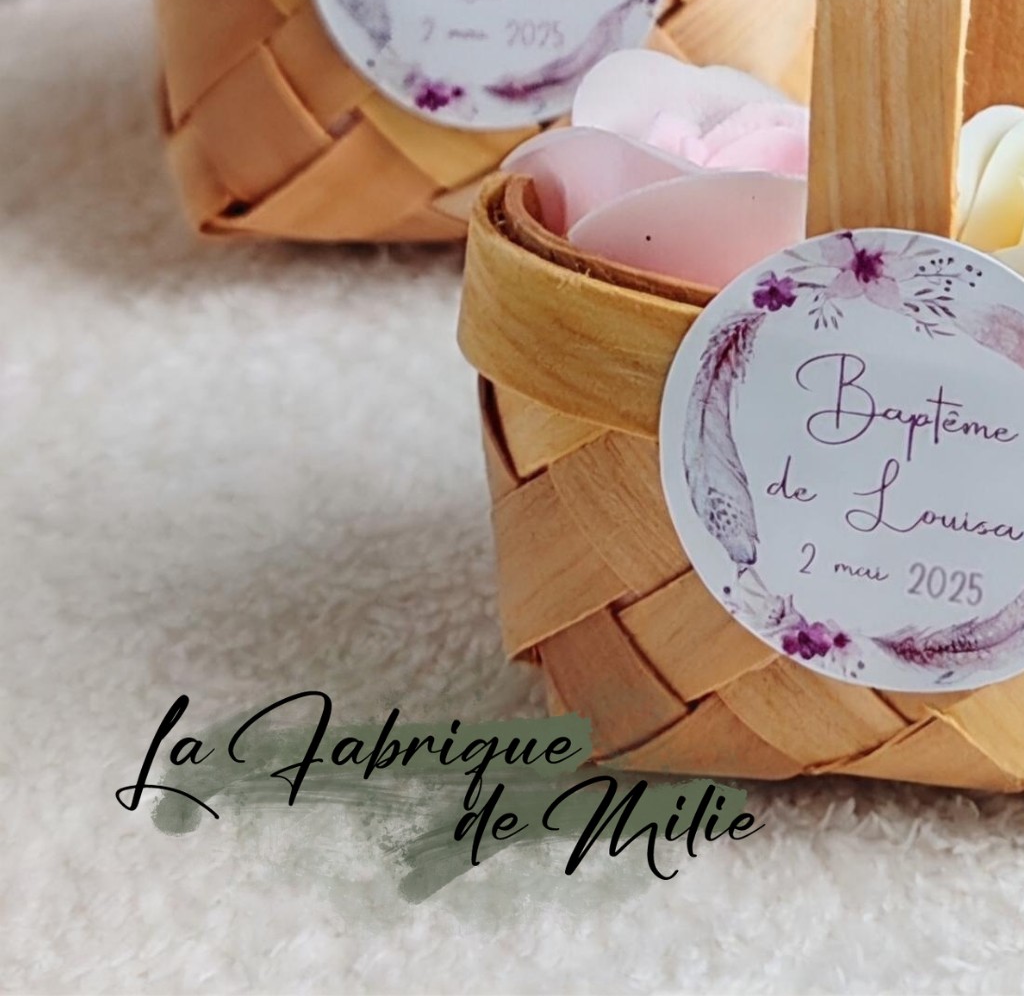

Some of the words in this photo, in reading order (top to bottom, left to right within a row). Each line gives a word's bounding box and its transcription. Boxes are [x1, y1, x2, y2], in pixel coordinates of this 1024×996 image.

[795, 353, 1019, 462] Baptême
[766, 455, 818, 503] de
[845, 458, 1024, 541] Louisa
[798, 542, 817, 575] 2
[833, 561, 889, 582] mai
[906, 561, 984, 606] 2025
